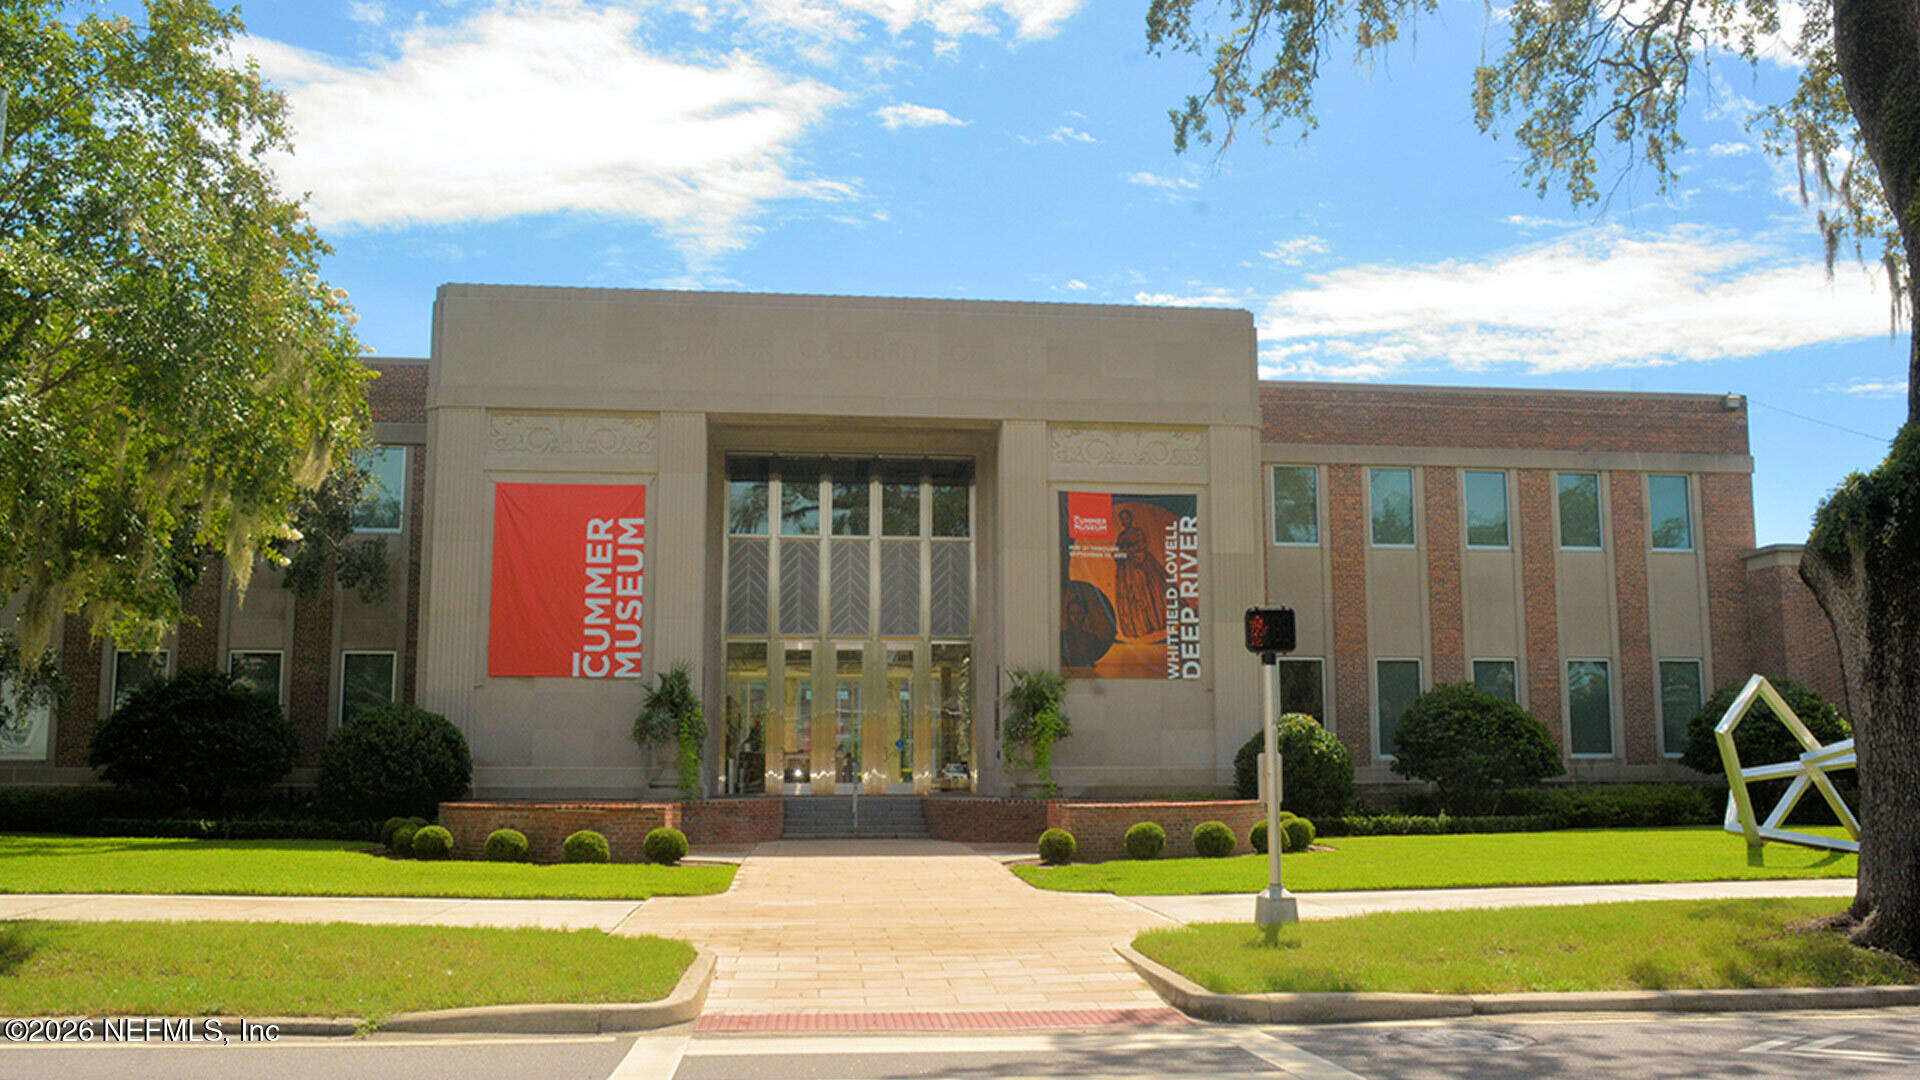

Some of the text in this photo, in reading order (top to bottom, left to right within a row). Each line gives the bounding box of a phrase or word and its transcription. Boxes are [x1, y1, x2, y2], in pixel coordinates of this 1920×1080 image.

[582, 518, 614, 677] CUMMER
[614, 517, 645, 677] MUSEUM
[1165, 520, 1180, 680] WHITFIELD LOVELL
[1179, 515, 1201, 680] DEEP RIVER
